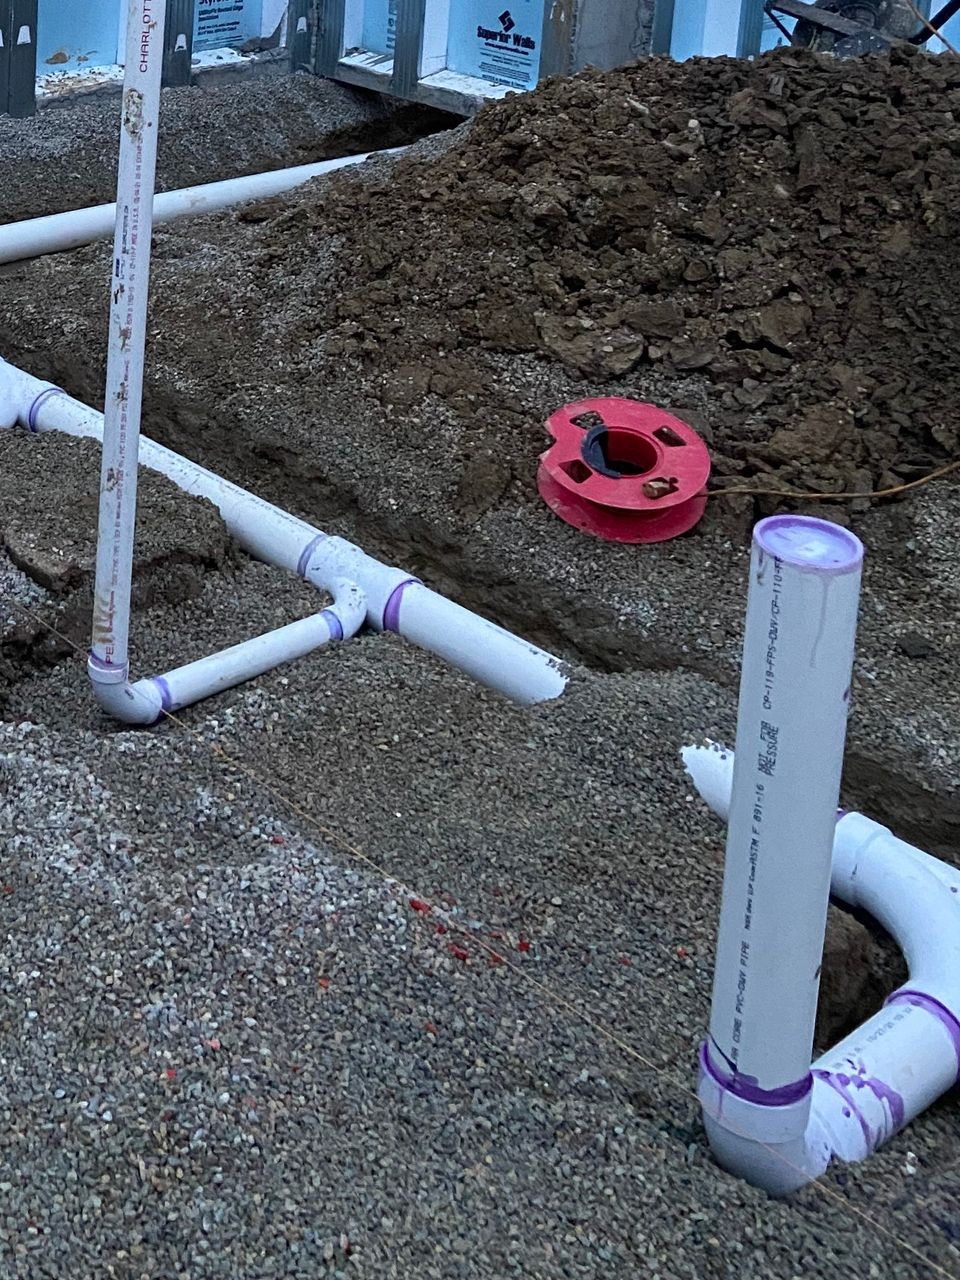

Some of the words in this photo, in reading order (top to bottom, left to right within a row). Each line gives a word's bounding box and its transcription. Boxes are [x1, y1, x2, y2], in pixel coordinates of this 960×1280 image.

[513, 33, 535, 50] Walls
[764, 725, 779, 777] PRESSURE
[753, 783, 764, 823] 891-16
[752, 826, 760, 835] F
[749, 839, 760, 866] ASTM
[741, 940, 750, 967] PIPE
[733, 1018, 742, 1043] CORE
